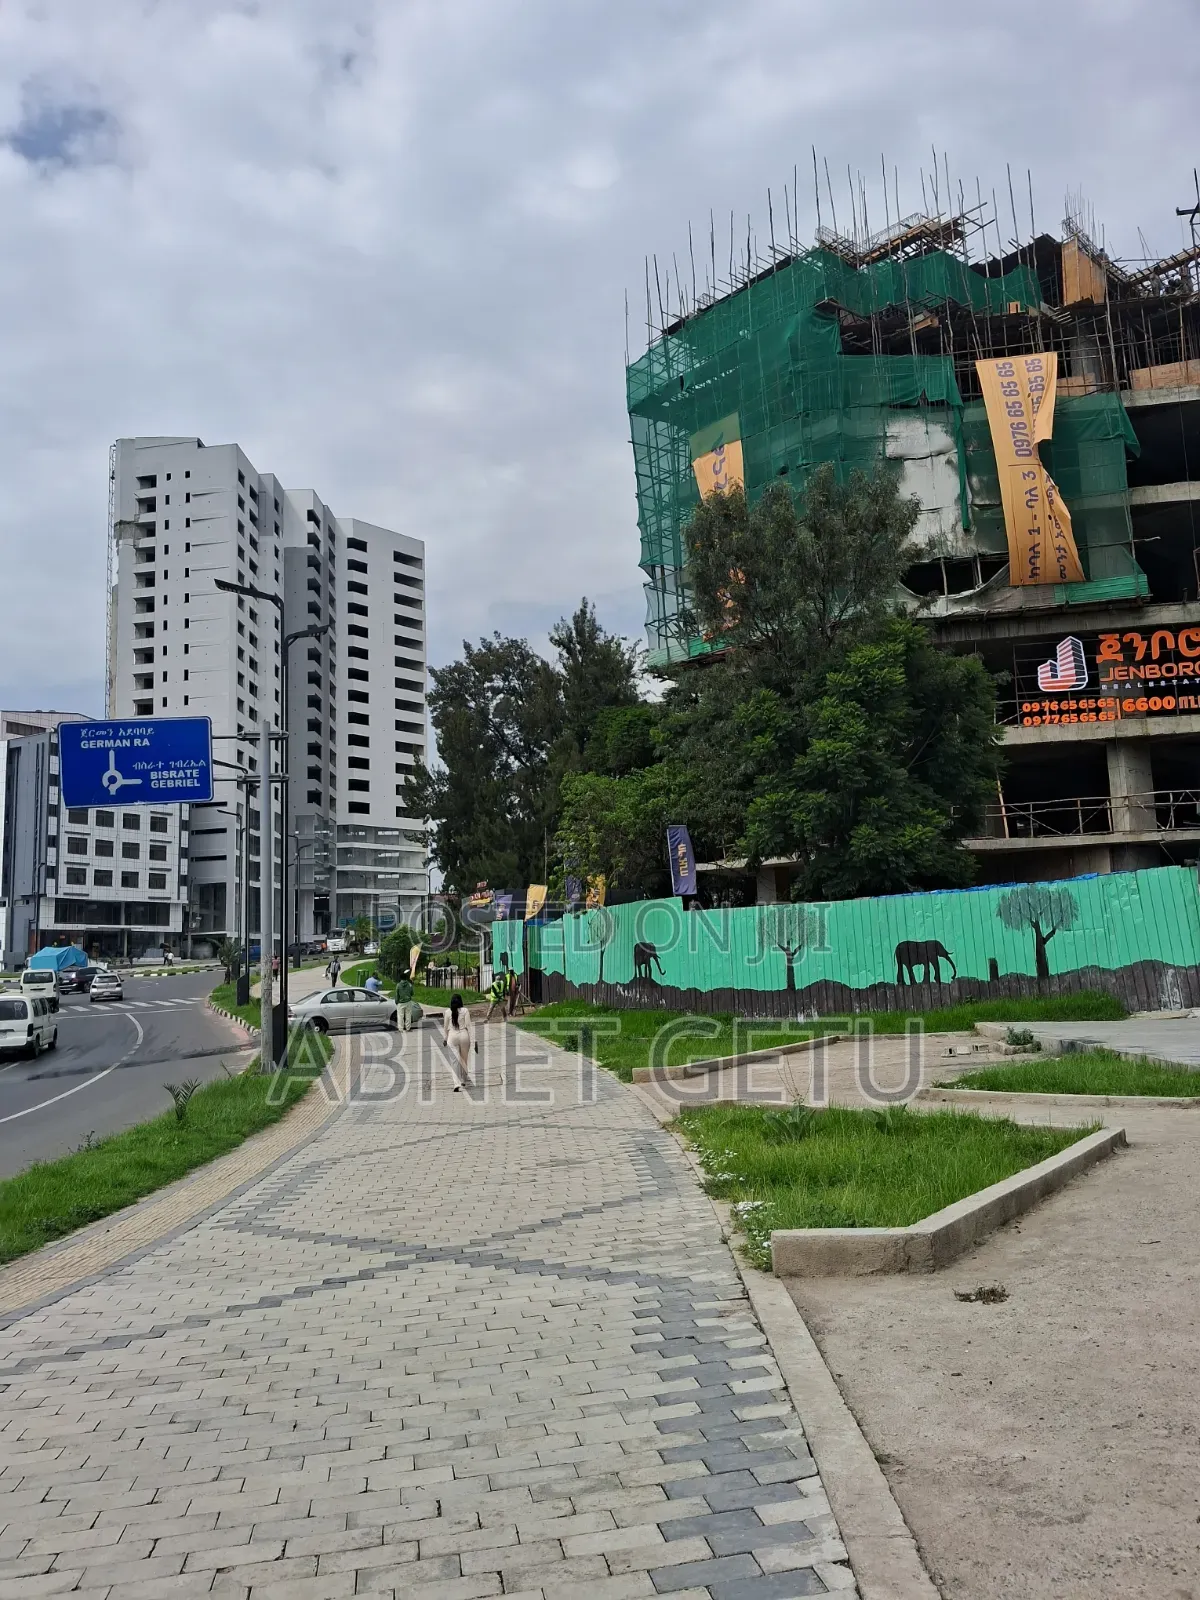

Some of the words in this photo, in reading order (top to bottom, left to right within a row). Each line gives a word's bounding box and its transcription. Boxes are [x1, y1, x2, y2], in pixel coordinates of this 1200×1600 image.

[995, 361, 1015, 378] 65
[1024, 358, 1043, 373] 65
[1001, 381, 1020, 397] 65
[1004, 400, 1023, 418] 65
[1010, 421, 1034, 457] 0976
[1021, 470, 1037, 481] 3
[1122, 696, 1176, 712] 6600
[80, 739, 131, 748] GERMAN
[133, 738, 150, 747] RA
[150, 769, 199, 780] BISRATE
[151, 779, 201, 789] GEBRIEL
